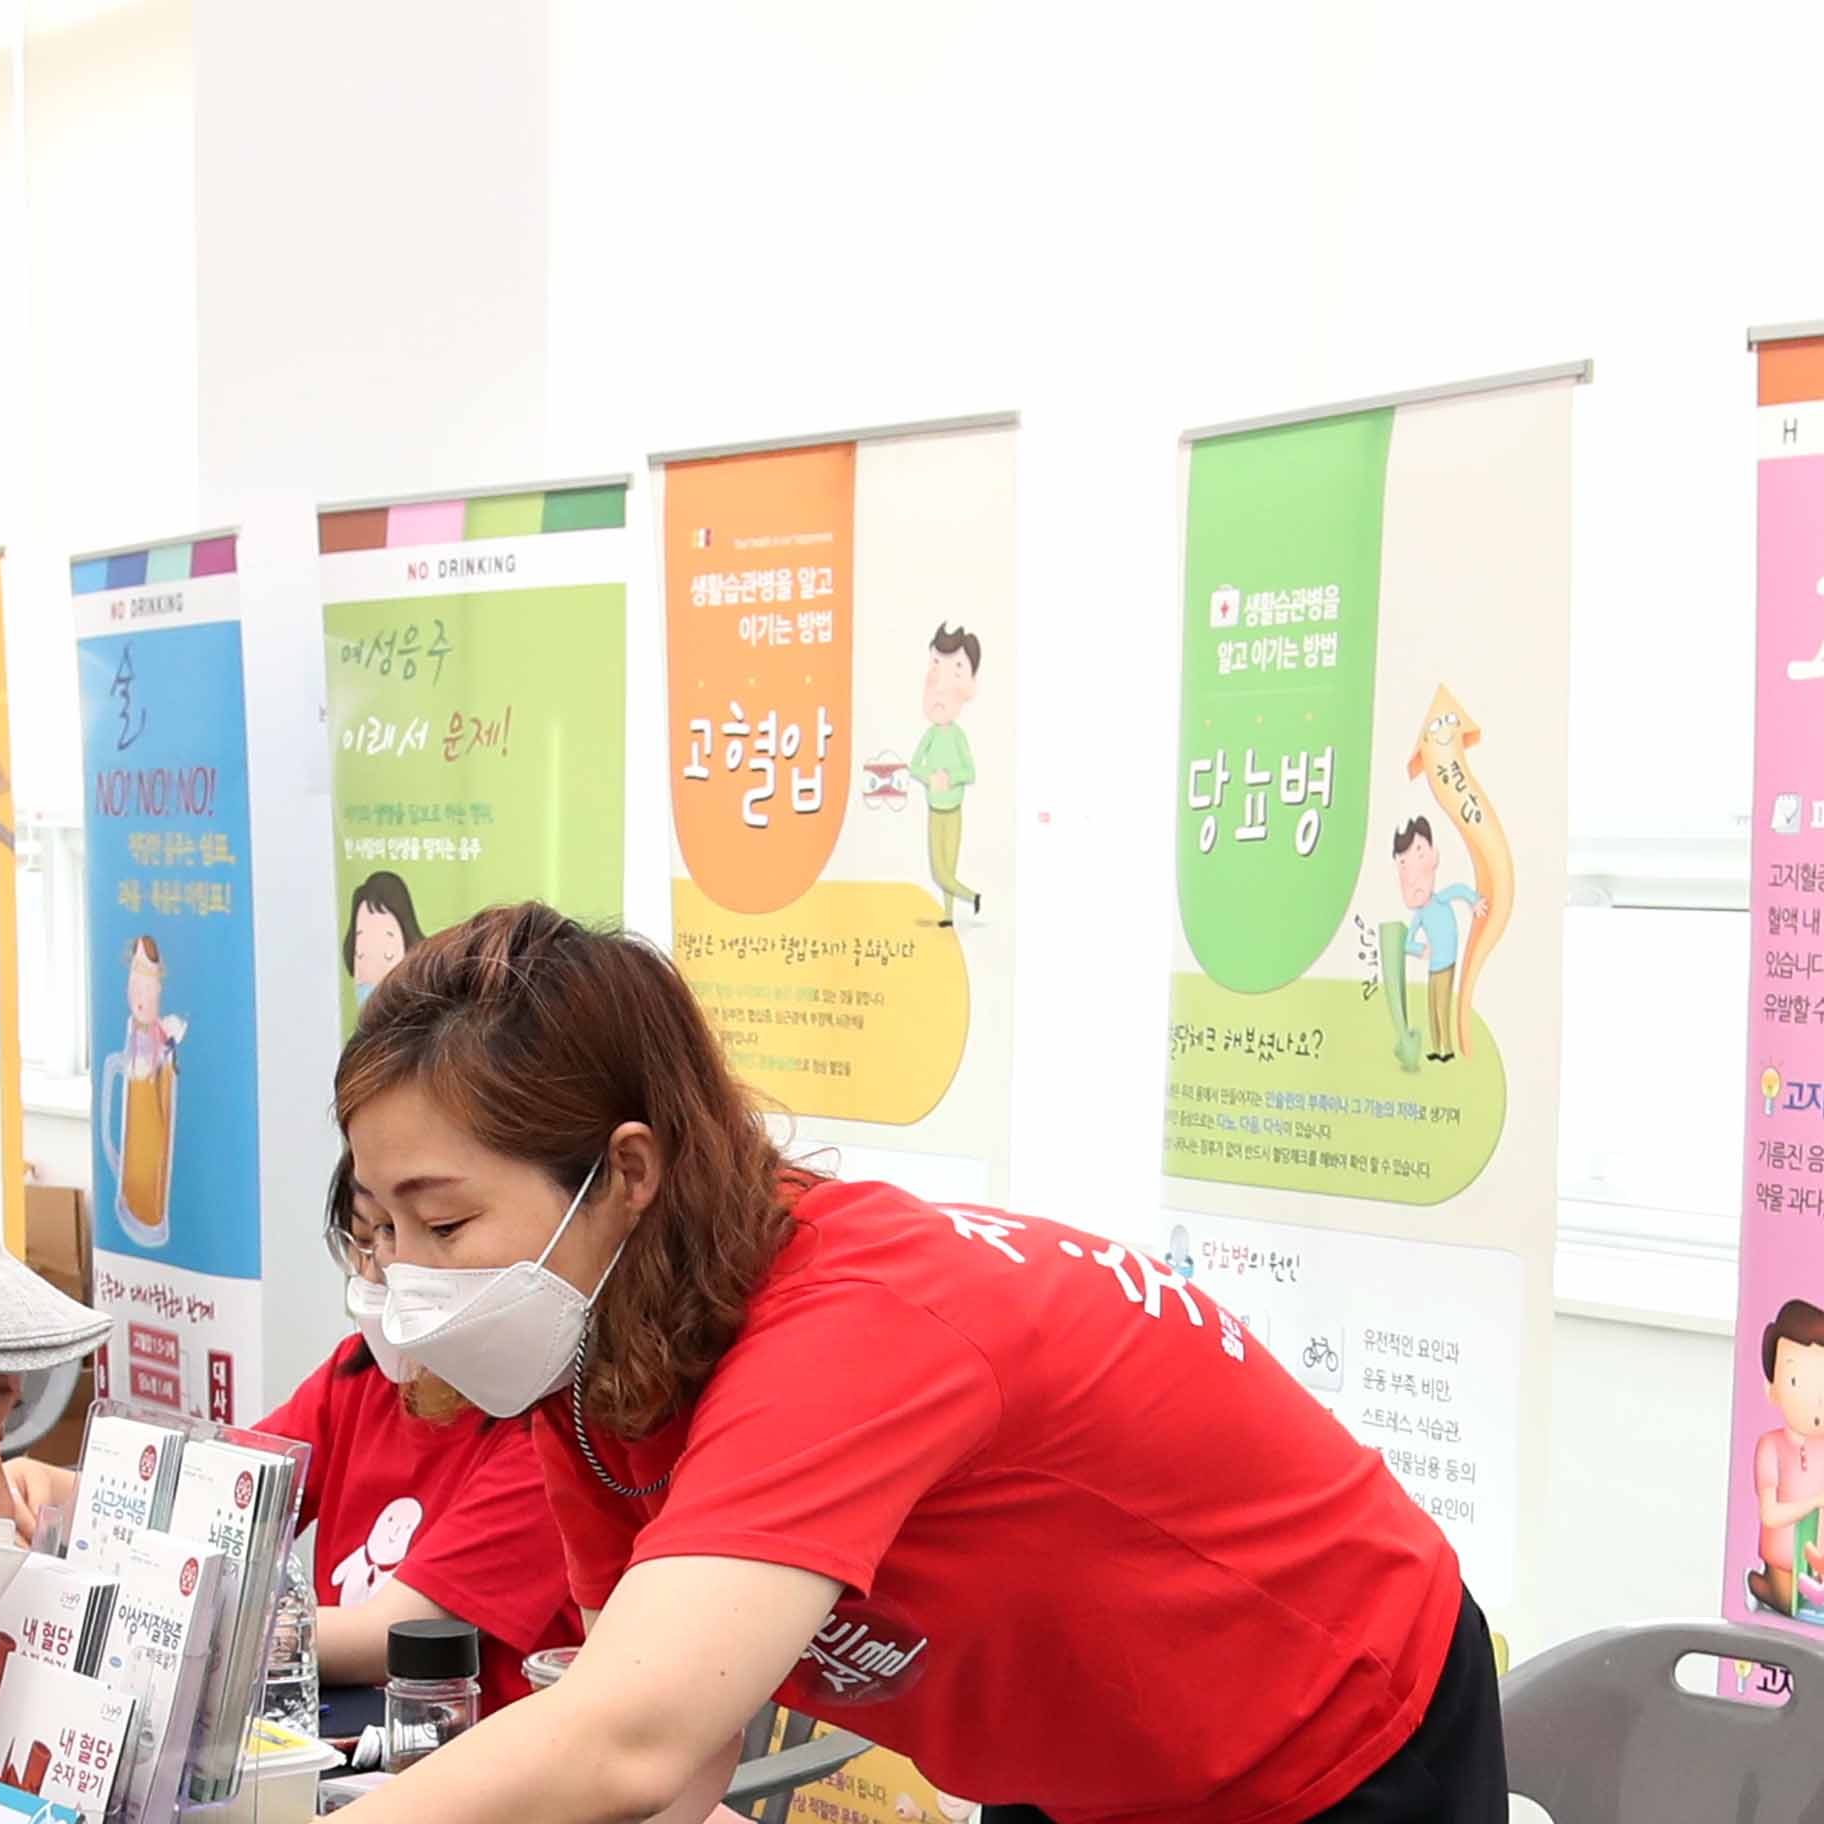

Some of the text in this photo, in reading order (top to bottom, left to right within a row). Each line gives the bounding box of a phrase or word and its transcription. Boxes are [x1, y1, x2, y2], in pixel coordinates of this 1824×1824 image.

[407, 554, 517, 581] NO DRINKING
[690, 566, 834, 608] 생활습관병을 알고
[1244, 584, 1341, 627] 생활습관병을
[739, 610, 834, 648] 이기는 방법
[341, 619, 453, 687] 여성음주
[1217, 632, 1339, 674] 알고 이기는 방법
[343, 705, 512, 763] 이래서 문제!
[683, 700, 833, 829] 고혈압
[176, 767, 216, 817] NO!
[1188, 745, 1336, 856] 당뇨병
[1768, 907, 1798, 936] 혈액
[1803, 909, 1821, 936] 내
[1757, 1141, 1804, 1171] 기름진
[1202, 1241, 1300, 1283] 당뇨병의 원인
[1363, 1328, 1461, 1365] 유전적인 요인과
[1363, 1367, 1386, 1393] 운동
[208, 1522, 244, 1558] 뇌졸중
[23, 1617, 75, 1656] 내 혈당
[118, 1604, 184, 1651] 이상지질혈증
[59, 1727, 114, 1770] 내 혈당
[52, 1761, 104, 1799] 숫자 알기
